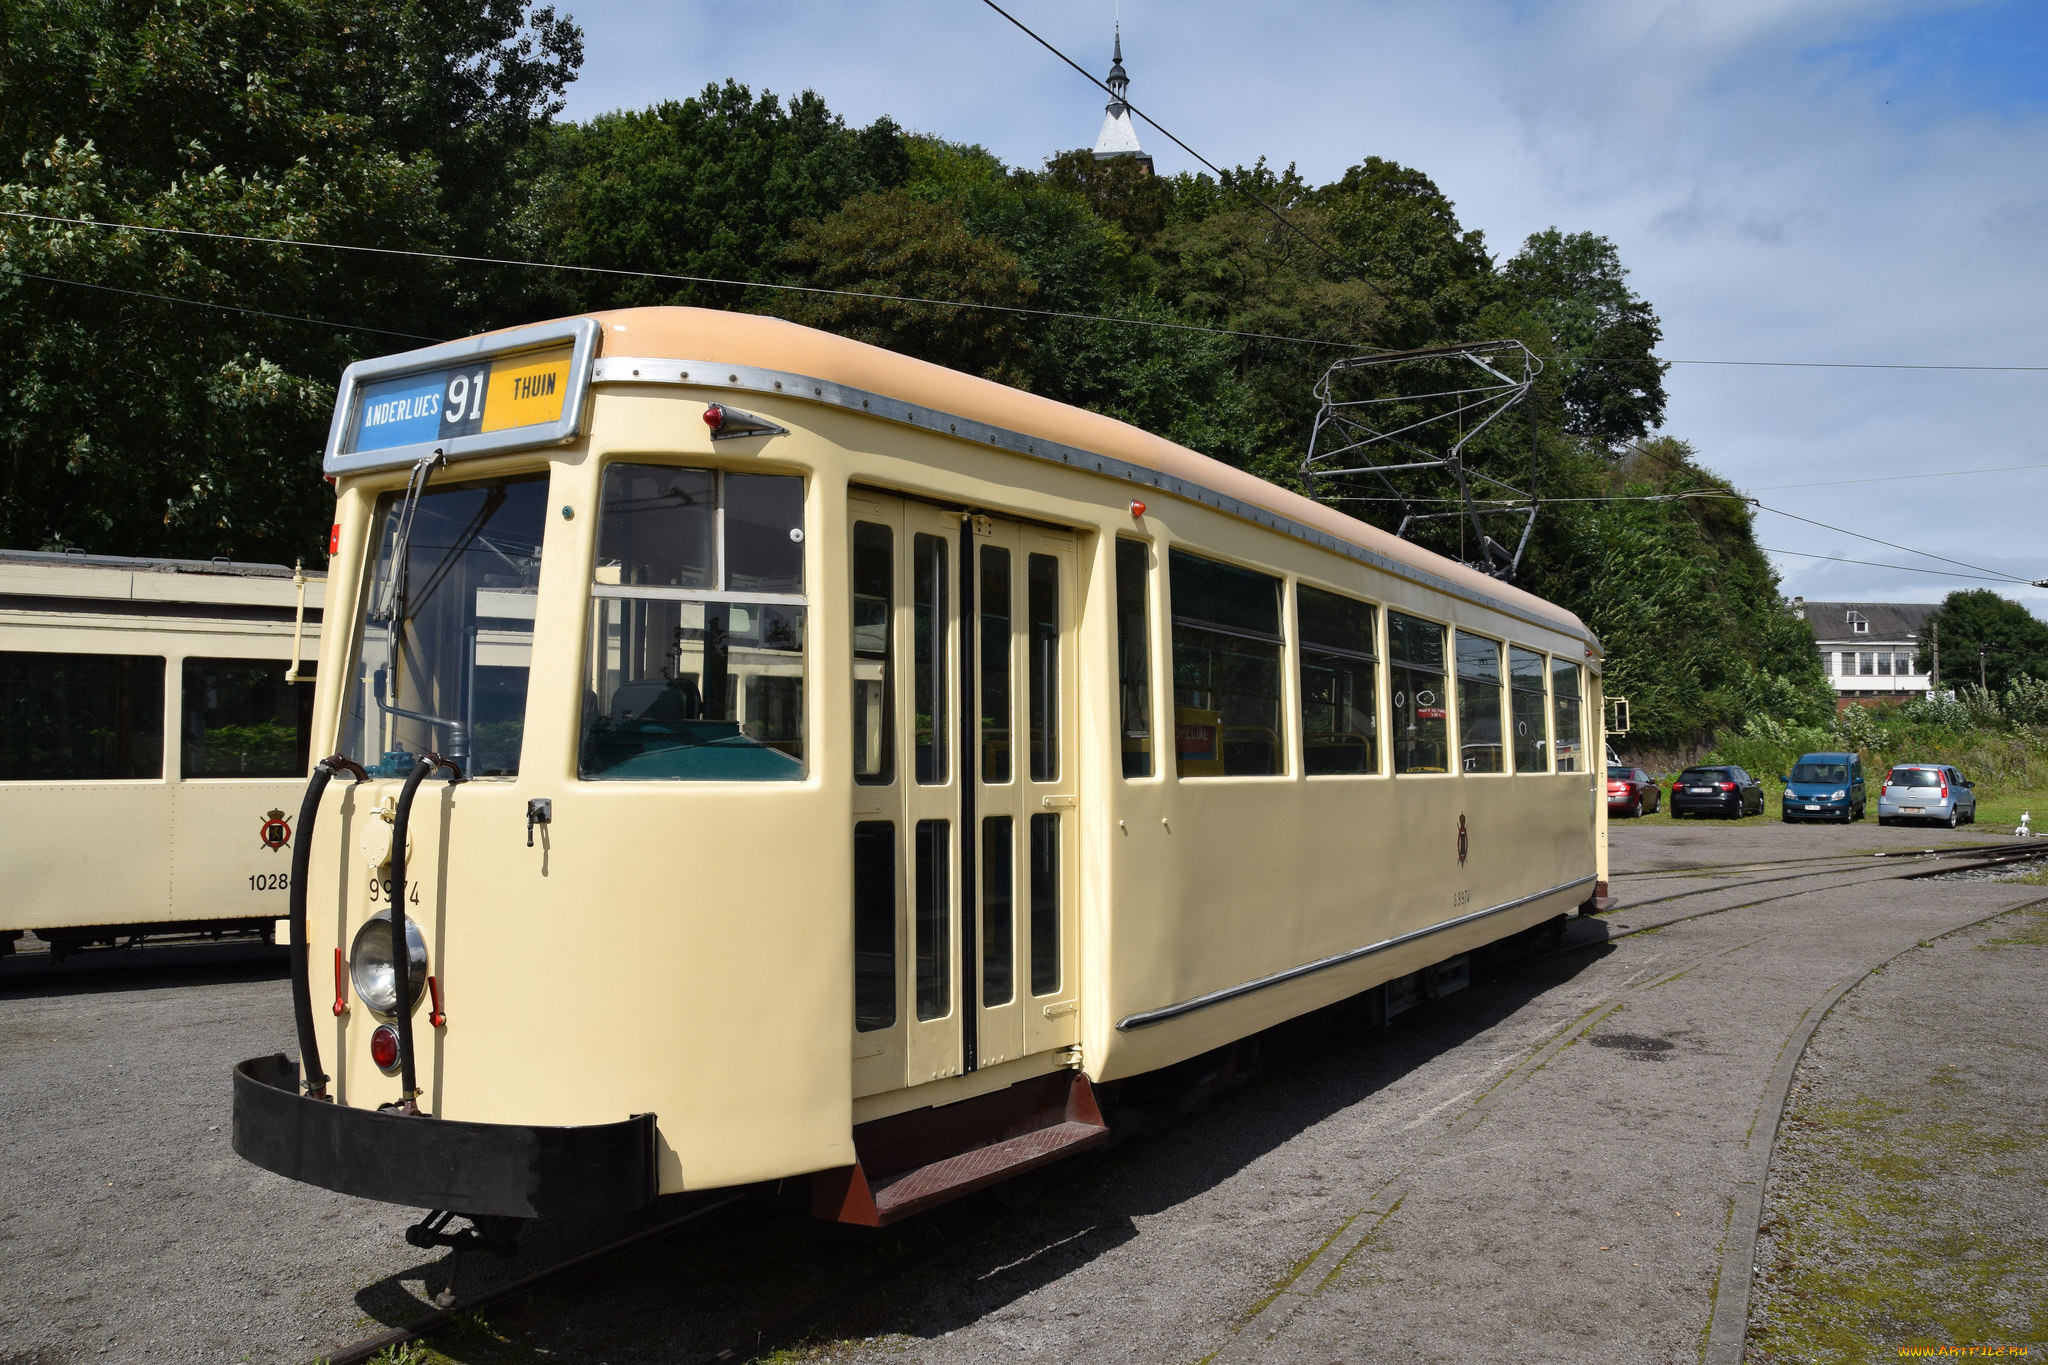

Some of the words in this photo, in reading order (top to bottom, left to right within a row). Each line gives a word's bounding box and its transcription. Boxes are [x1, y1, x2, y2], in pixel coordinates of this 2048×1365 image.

[364, 393, 440, 427] ANDERLUES
[445, 370, 485, 423] 91
[513, 372, 556, 401] THUIN
[248, 873, 292, 891] 1028
[369, 878, 420, 906] 994
